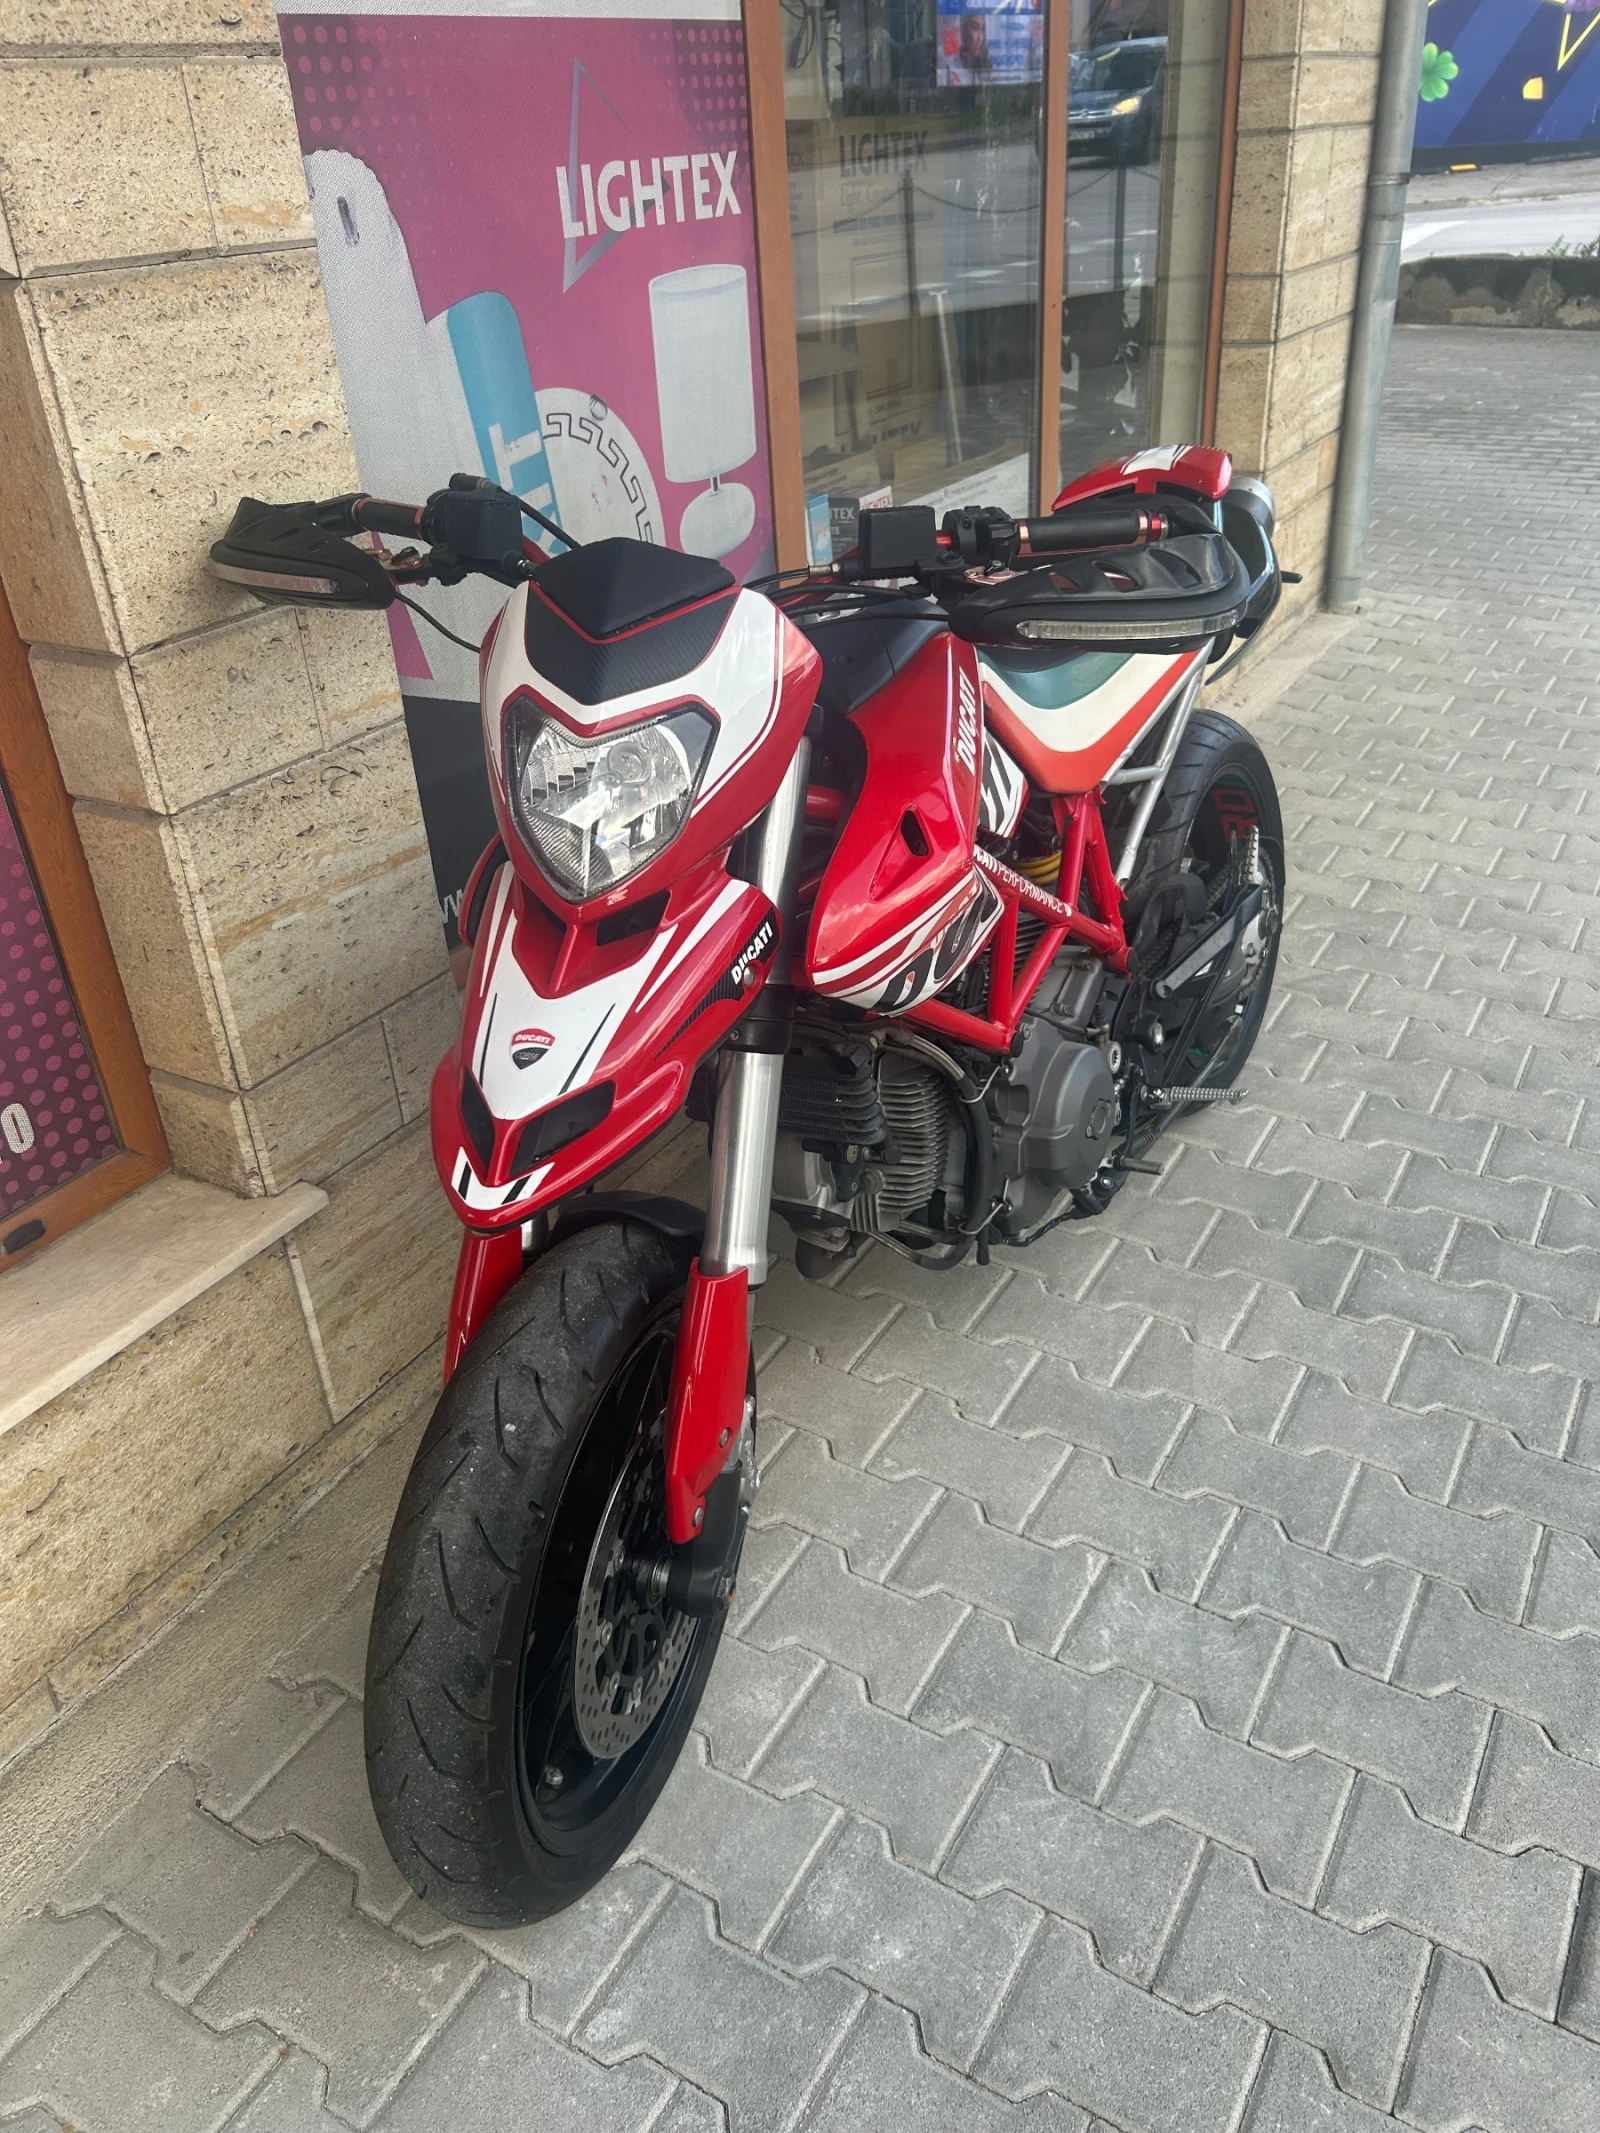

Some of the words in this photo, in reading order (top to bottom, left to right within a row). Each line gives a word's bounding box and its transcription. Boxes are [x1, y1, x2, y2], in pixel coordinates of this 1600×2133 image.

[839, 130, 927, 178] LIGHTEX
[556, 151, 742, 239] LIGHTEX
[957, 666, 976, 776] DUCATI
[997, 861, 1064, 914] PERFORMANCE
[731, 921, 773, 985] DUCATI
[515, 1034, 551, 1044] DUCATI
